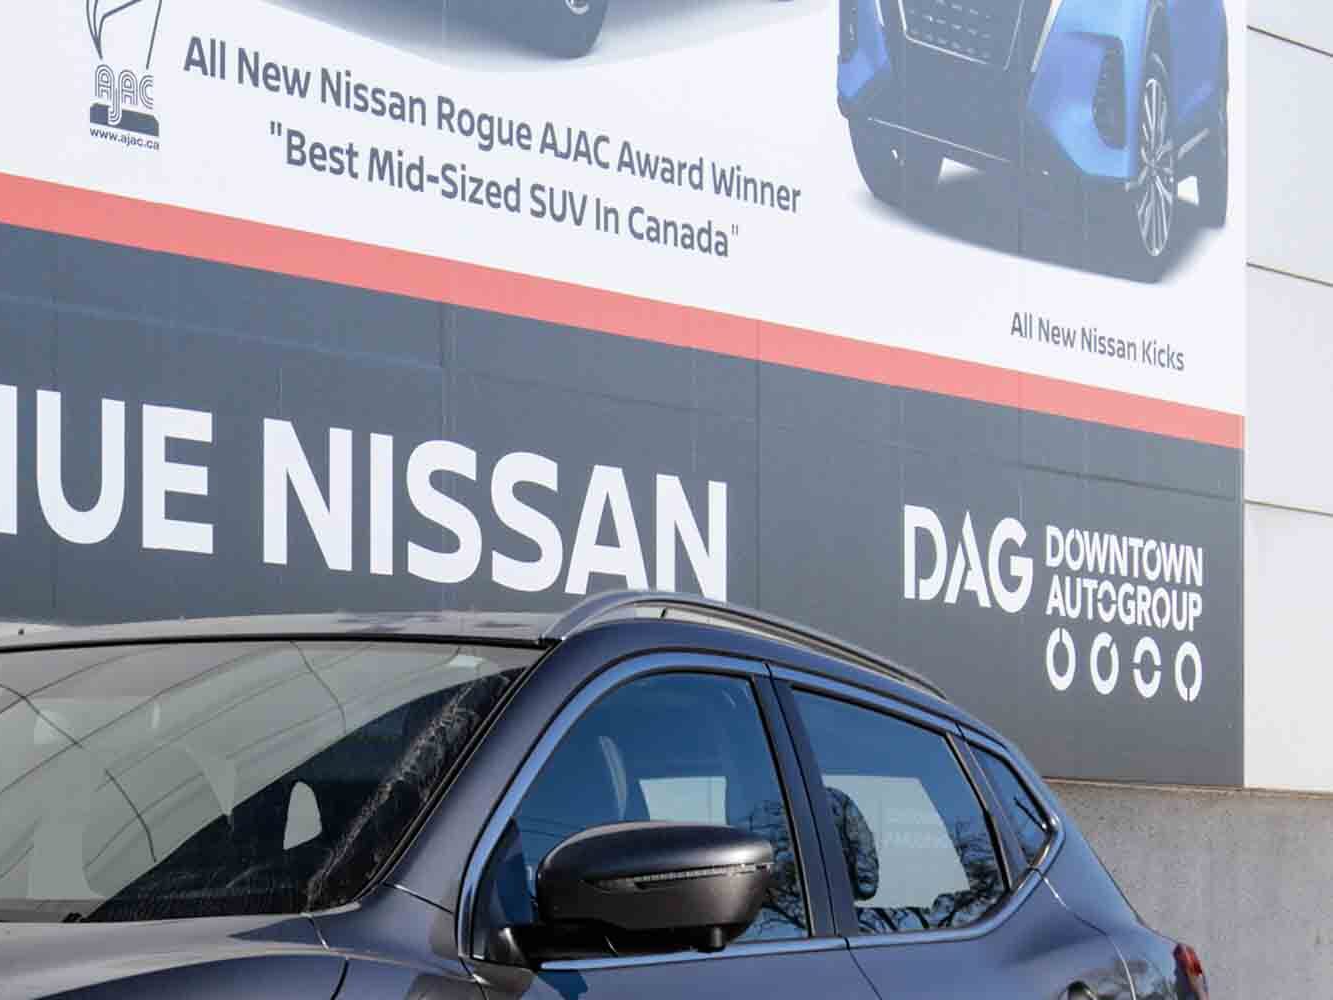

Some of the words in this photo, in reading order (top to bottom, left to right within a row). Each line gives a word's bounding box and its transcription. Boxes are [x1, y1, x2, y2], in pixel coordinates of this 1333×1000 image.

[94, 64, 155, 125] AJAC
[183, 36, 226, 80] All
[237, 47, 311, 98] New
[320, 68, 427, 126] Nissan
[436, 95, 533, 151] Rogue
[539, 121, 611, 169] AJAC
[617, 141, 704, 191] Award
[711, 162, 802, 213] Winner
[90, 128, 160, 151] www.ajac.ca
[270, 121, 358, 179] "Best
[368, 147, 521, 214] Mid-Sized
[529, 182, 587, 227] SUV
[595, 197, 619, 235] In
[628, 206, 739, 257] Canada"
[1010, 311, 1033, 340] All
[1038, 317, 1077, 349] New
[1081, 327, 1137, 361] Nissan
[1142, 338, 1185, 372] Kicks
[263, 417, 728, 602] NISSAN
[904, 504, 1034, 613] DAG
[1046, 525, 1203, 587] DOWNTOWN
[1045, 574, 1203, 632] AUTOGROUP
